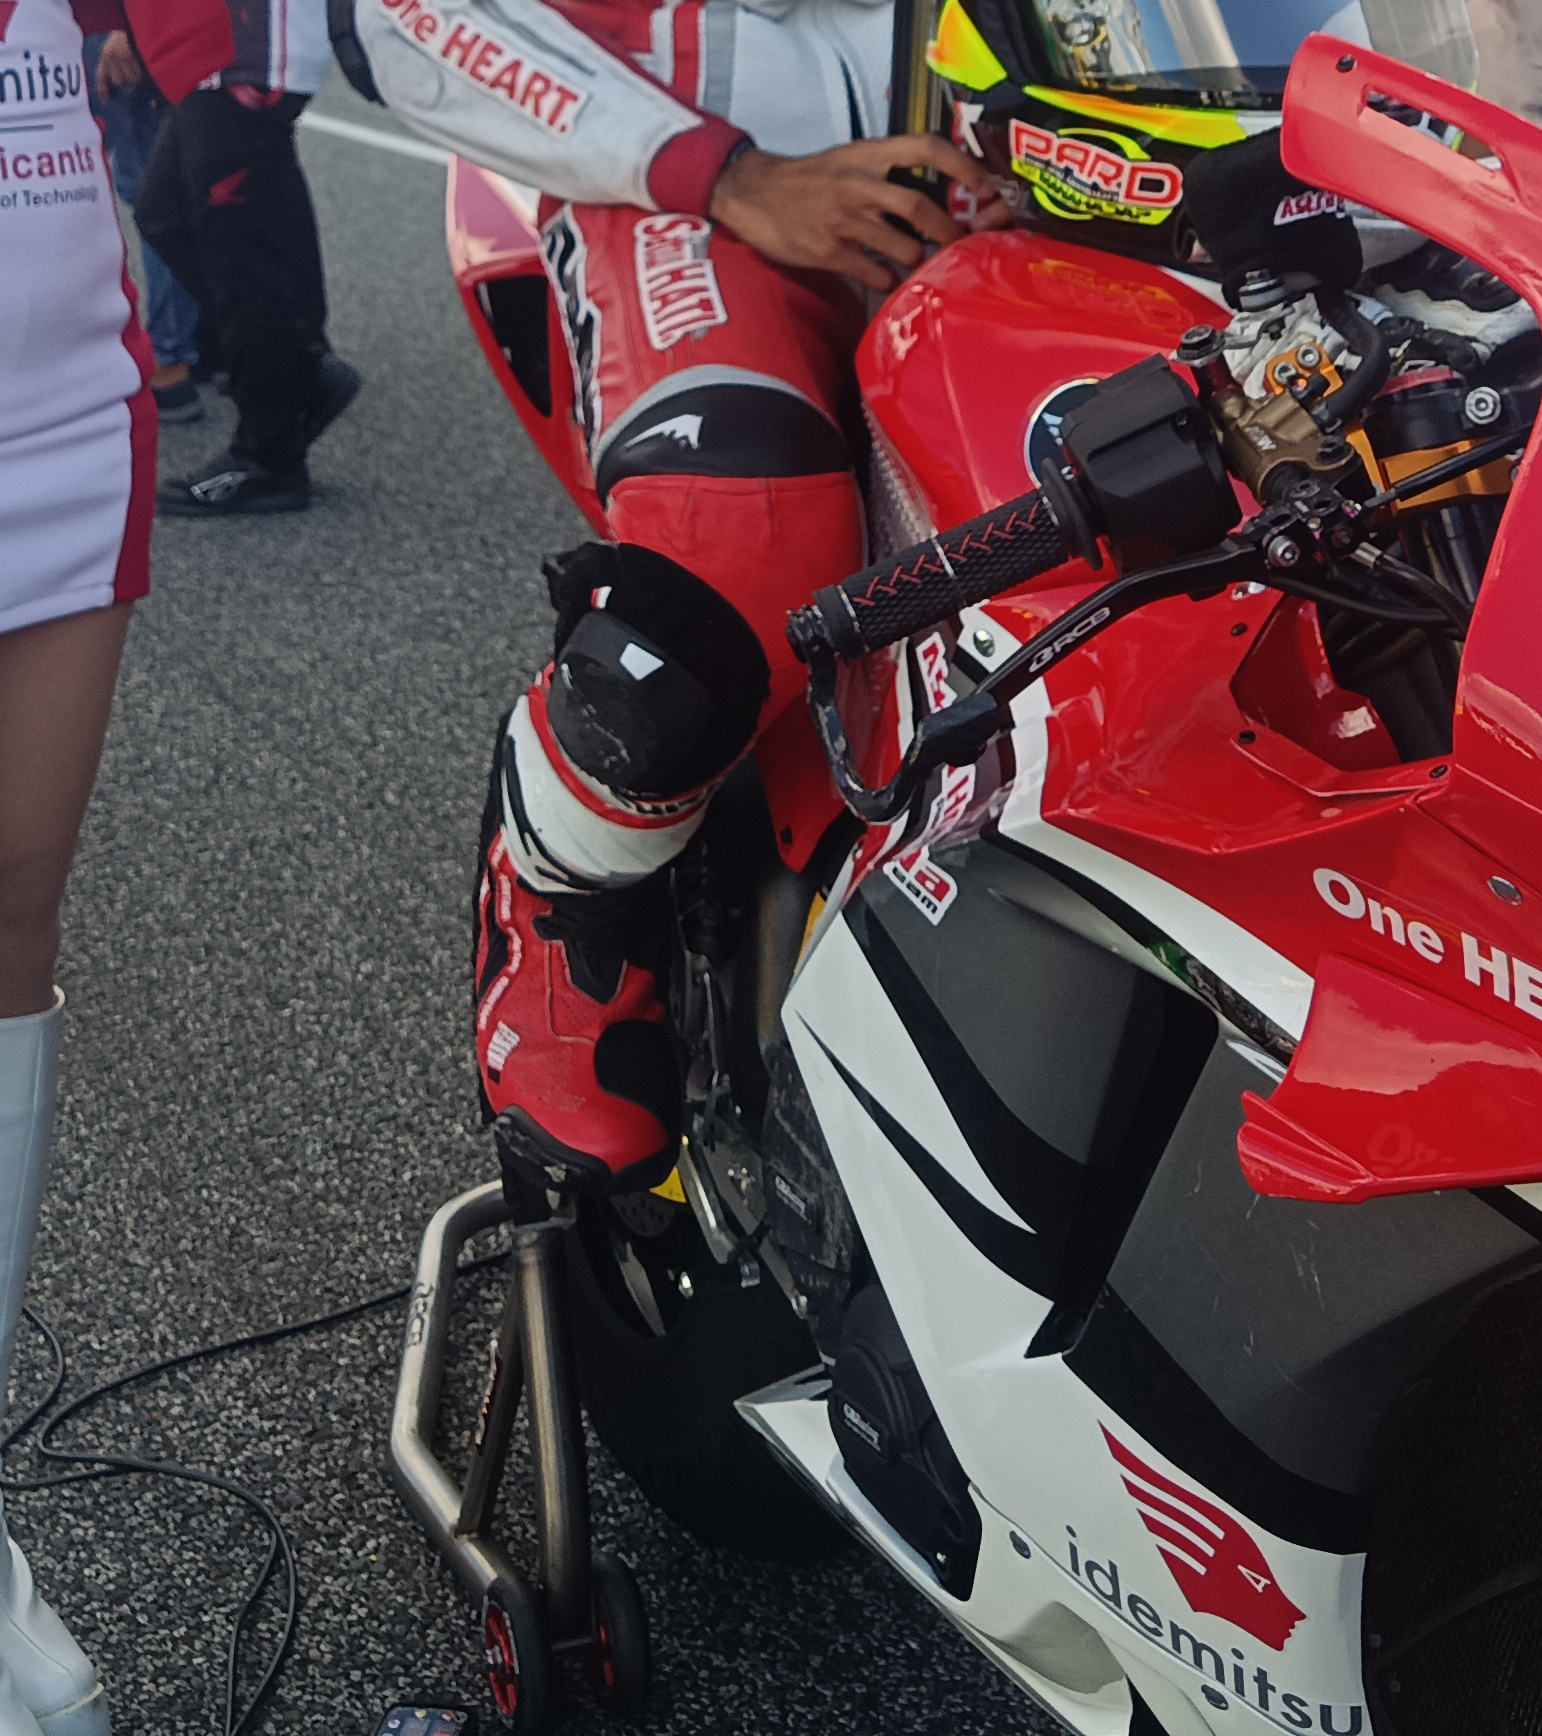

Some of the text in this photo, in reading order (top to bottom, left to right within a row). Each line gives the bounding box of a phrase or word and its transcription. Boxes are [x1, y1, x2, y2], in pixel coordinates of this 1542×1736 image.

[441, 23, 581, 134] HEART.
[0, 191, 18, 209] of
[1311, 867, 1449, 964] One
[1065, 1522, 1365, 1736] idemitsu
